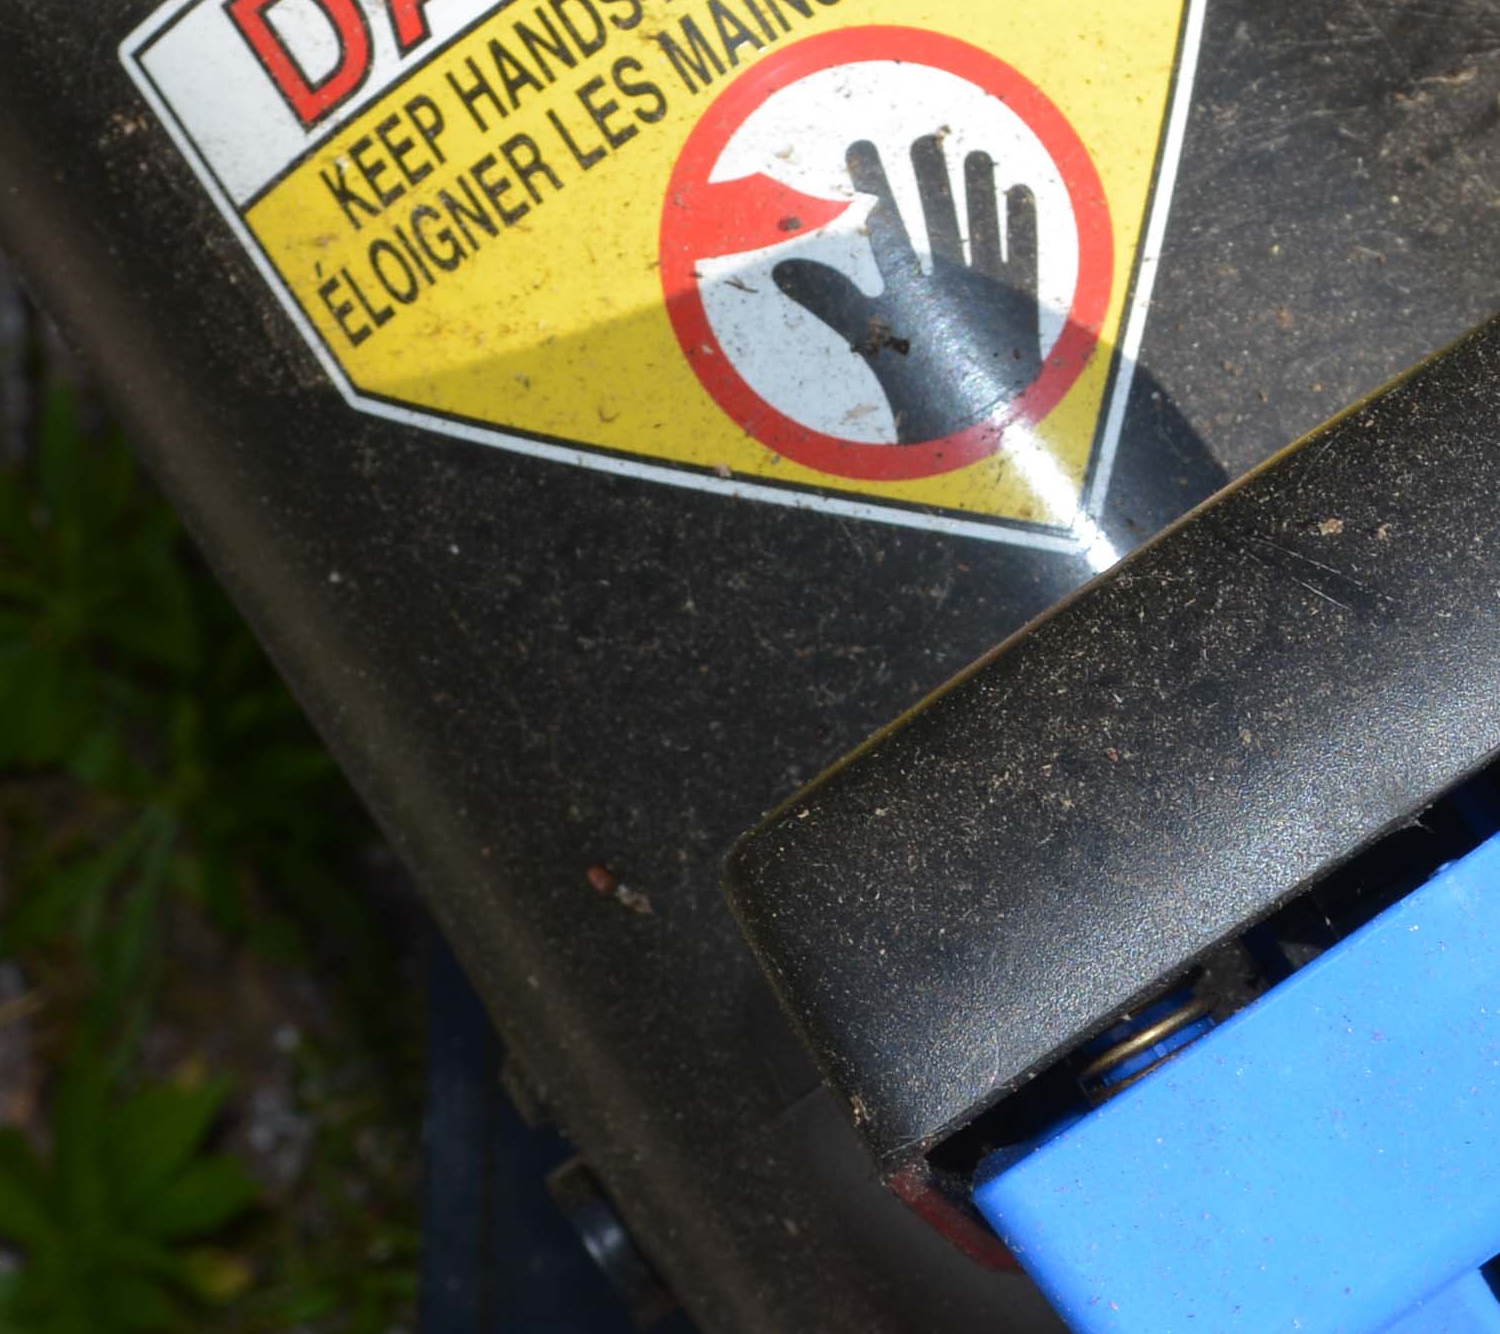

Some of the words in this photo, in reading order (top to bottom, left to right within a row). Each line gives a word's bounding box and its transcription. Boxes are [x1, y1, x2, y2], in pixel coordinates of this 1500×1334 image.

[315, 132, 565, 348] ÉLOIGNER
[545, 56, 668, 171] LES
[319, 94, 447, 231] KEEP
